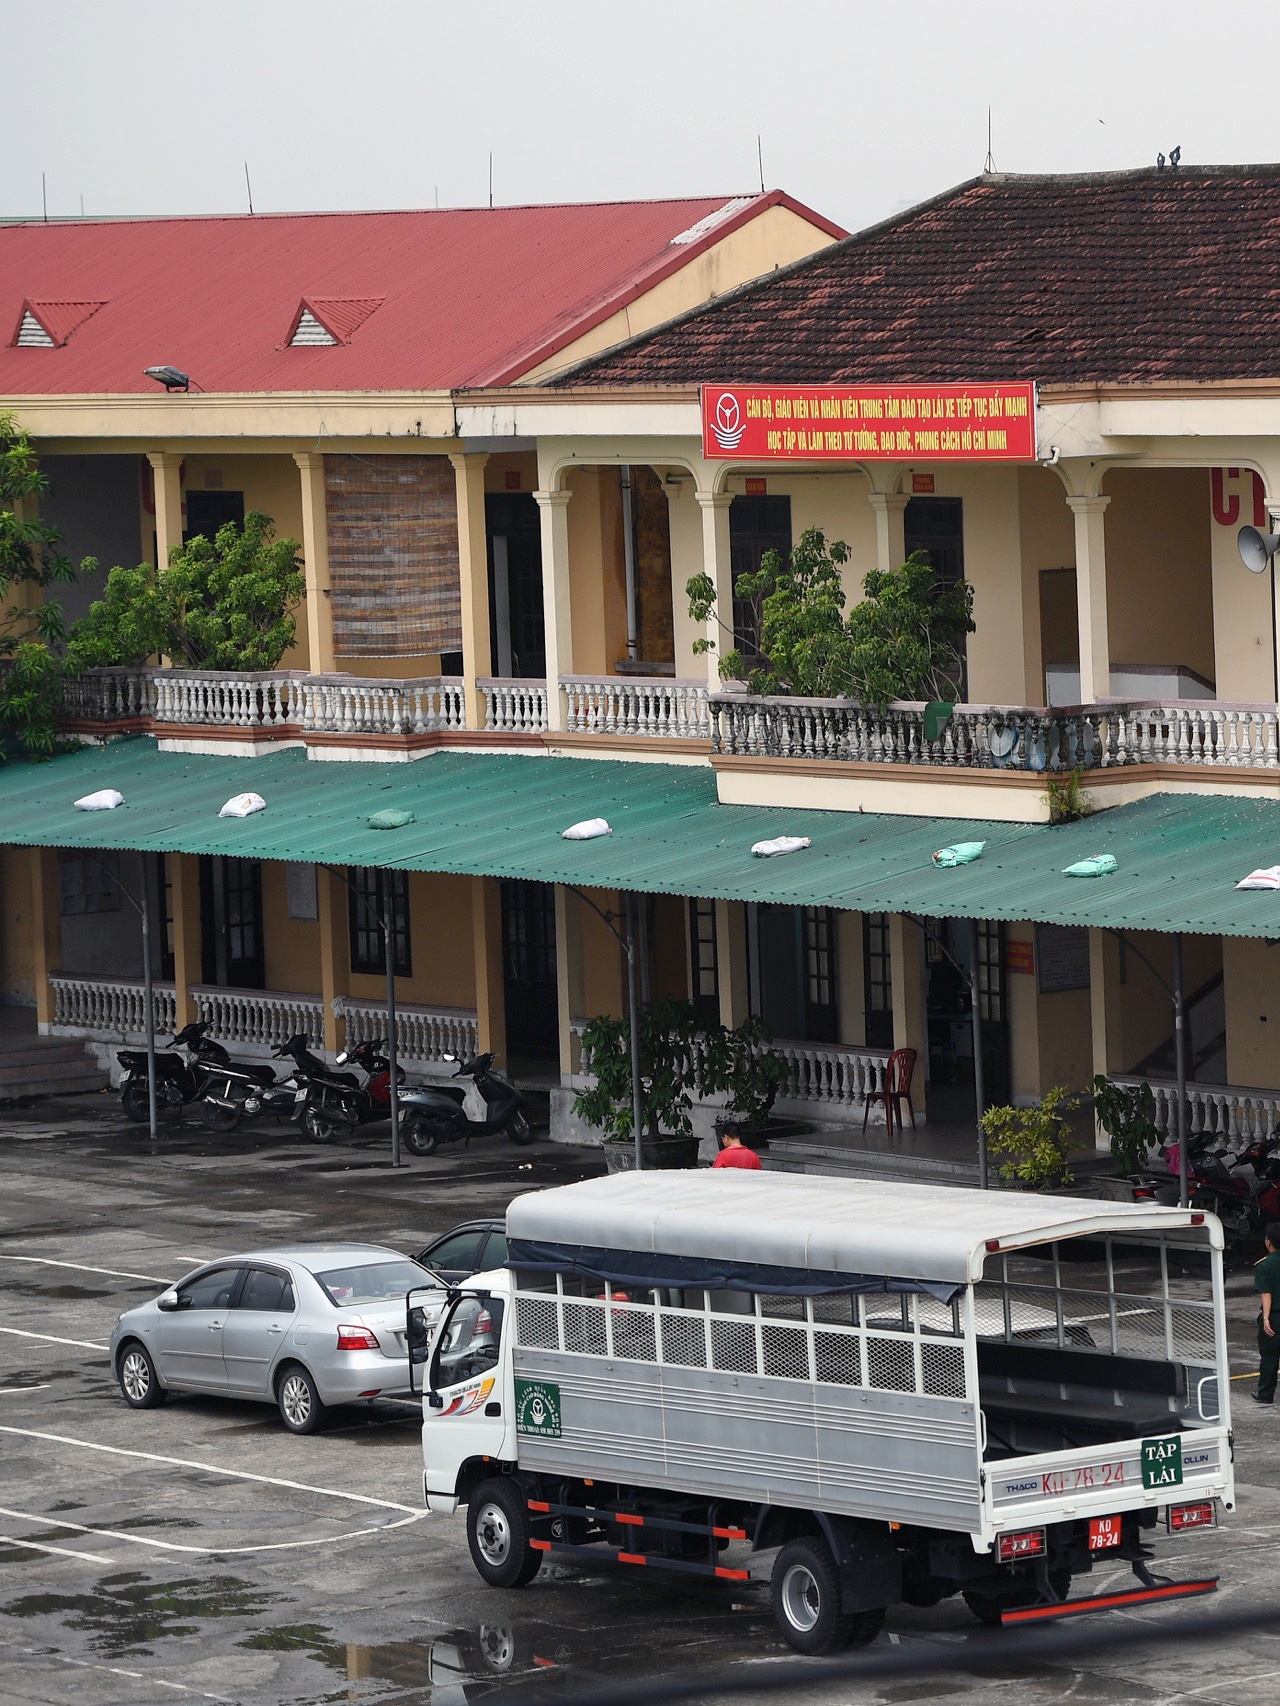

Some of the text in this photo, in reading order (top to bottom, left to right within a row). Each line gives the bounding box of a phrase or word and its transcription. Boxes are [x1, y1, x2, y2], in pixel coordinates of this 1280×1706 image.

[746, 389, 1027, 422] CÁN BỘ, GIÁO VIÊN VÀ NHÂN VIÊN TRUNG TÂM ĐÀO TẠO LÁI XE TIẾP TỤC ĐẨY MẠNH
[767, 423, 1007, 455] HỌC TẬP VÀ LÀM THEO TƯ TƯỞNG, ĐẠO ĐỨC, PHONG CÁCH HỒ CHÍ MINH
[1145, 1441, 1177, 1462] TẬP
[1184, 1455, 1209, 1464] OLLIN
[1149, 1465, 1176, 1485] LÁI
[1006, 1482, 1037, 1493] THACO
[1099, 1519, 1111, 1533] KD
[1090, 1532, 1118, 1549] 78-24
